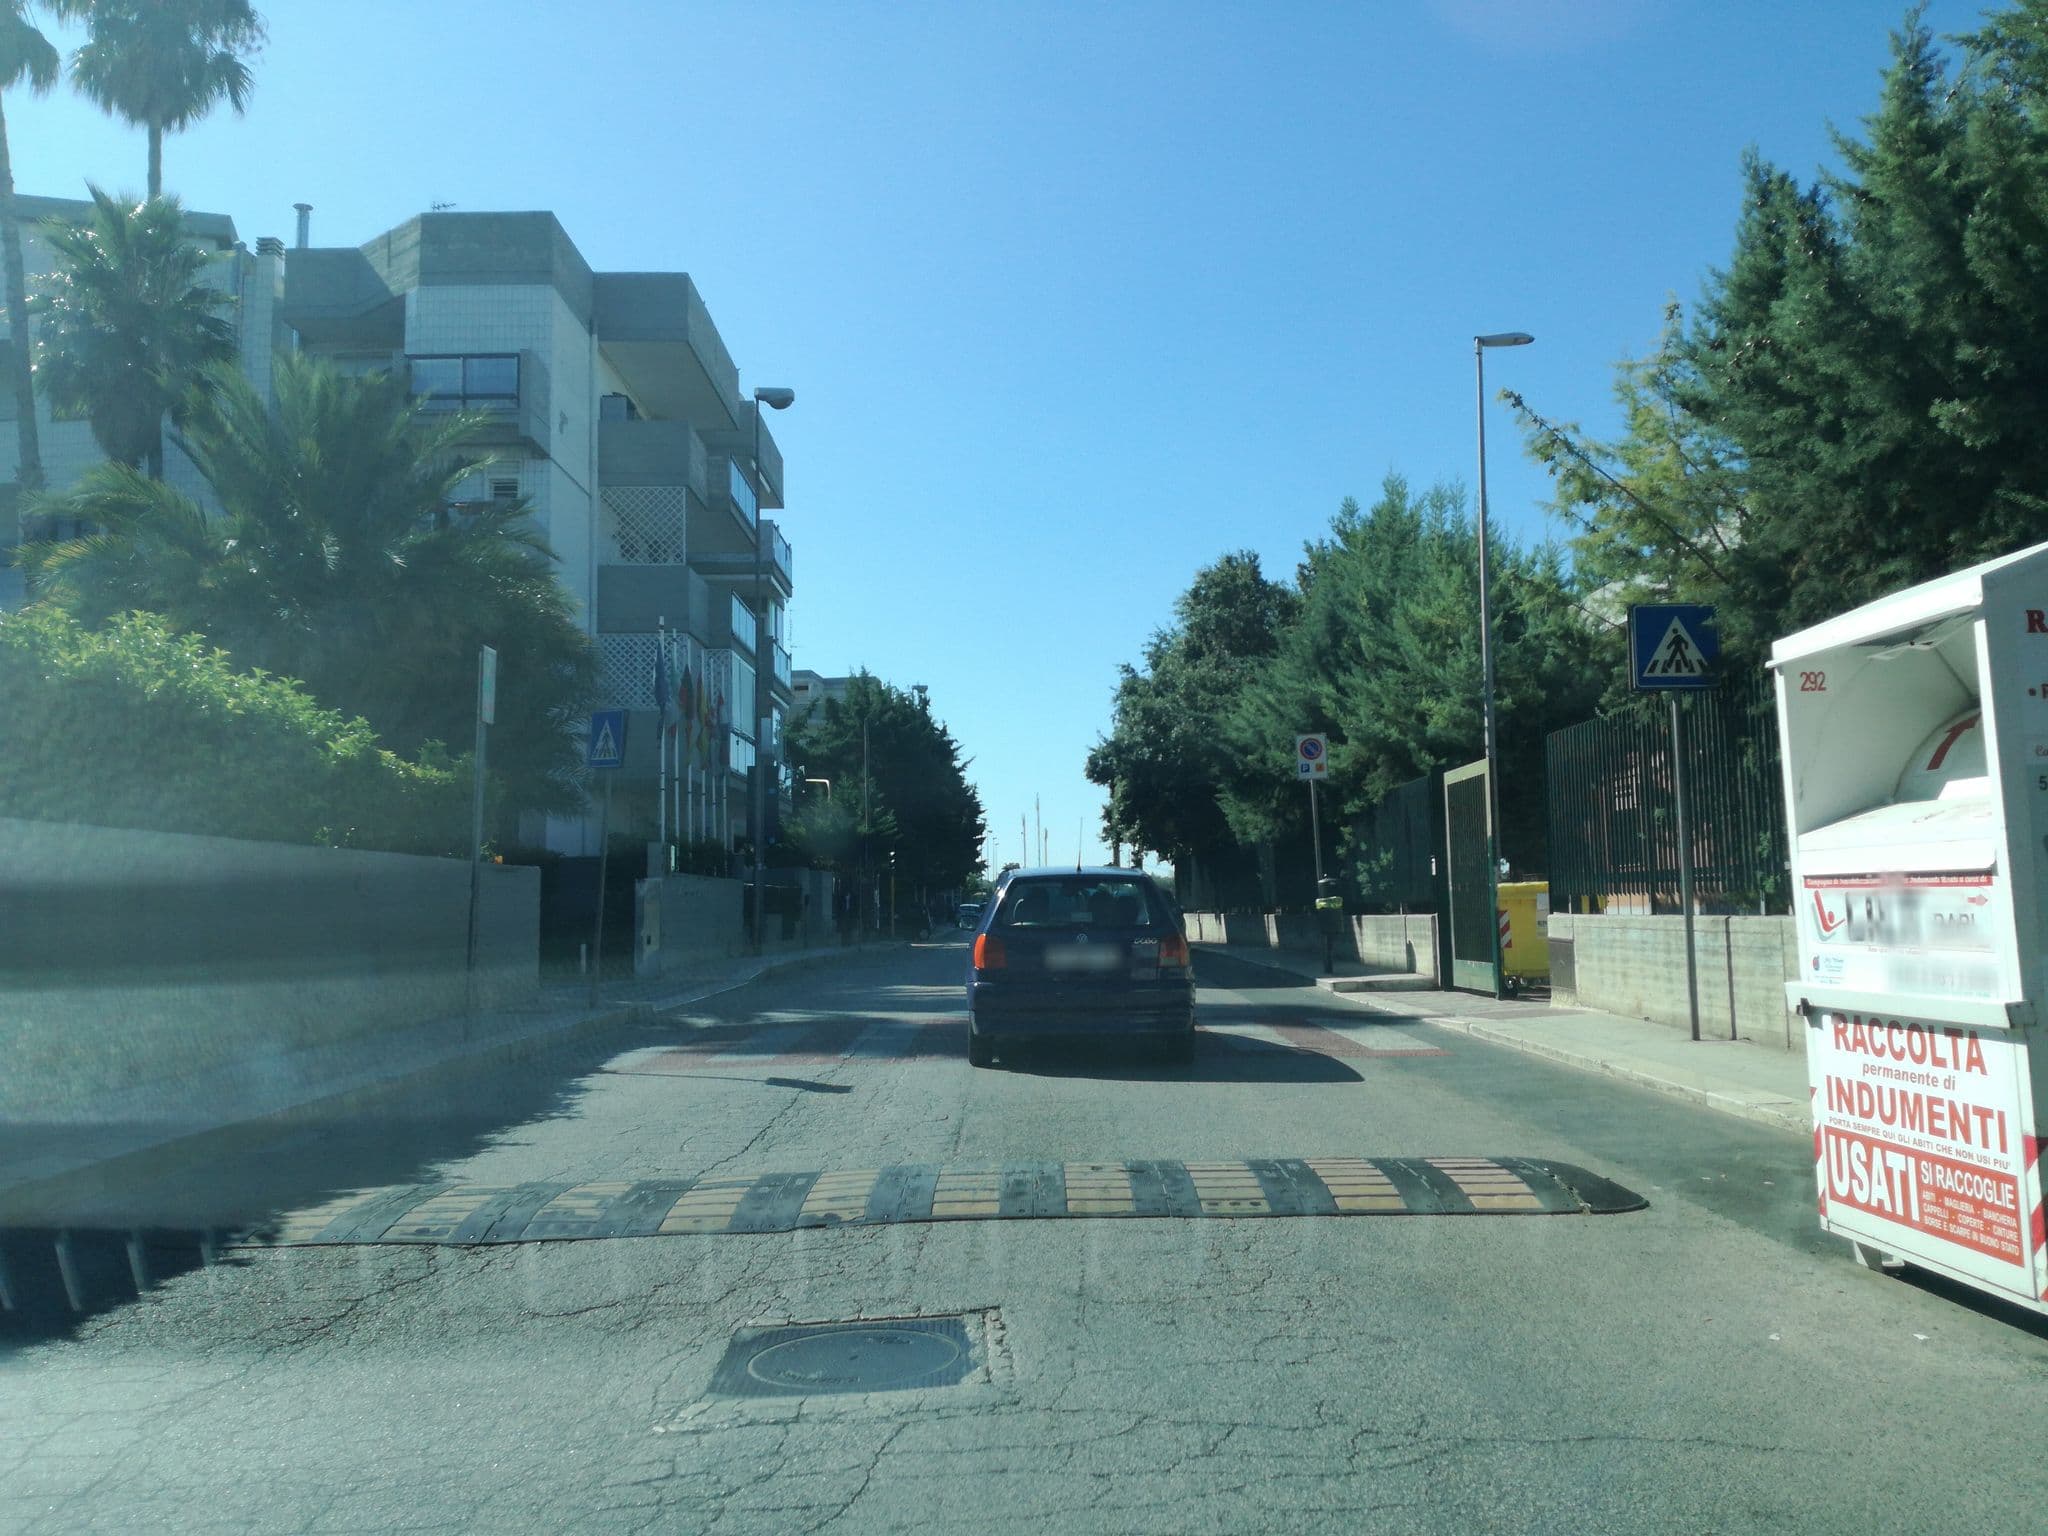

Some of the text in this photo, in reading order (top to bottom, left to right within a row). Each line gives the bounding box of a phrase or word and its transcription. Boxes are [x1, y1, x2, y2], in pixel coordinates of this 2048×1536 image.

[1800, 671, 1826, 691] 292
[1832, 1012, 1988, 1075] RACCOLTA
[1862, 1062, 1956, 1091] permanente di
[1826, 1075, 2008, 1154] INDUMENTI
[1829, 1116, 1851, 1128] PORTA
[1852, 1122, 1880, 1136] SEMPRE
[1882, 1129, 1896, 1140] QUI
[1898, 1134, 1910, 1144] GLI
[1913, 1137, 1934, 1150] ABITI
[1935, 1143, 1953, 1155] CHE
[1955, 1148, 1974, 1160] NON
[1976, 1154, 1991, 1165] USI
[1828, 1134, 1920, 1222] USATI
[1920, 1160, 2016, 1210] SI RACCOGLIE
[1923, 1202, 1949, 1219] CAPPELLI
[1957, 1213, 1984, 1231] COPERTE
[1943, 1221, 1948, 1232] E
[1949, 1223, 1971, 1239] SCARPE
[1982, 1207, 2018, 1228] BIANCHERIA
